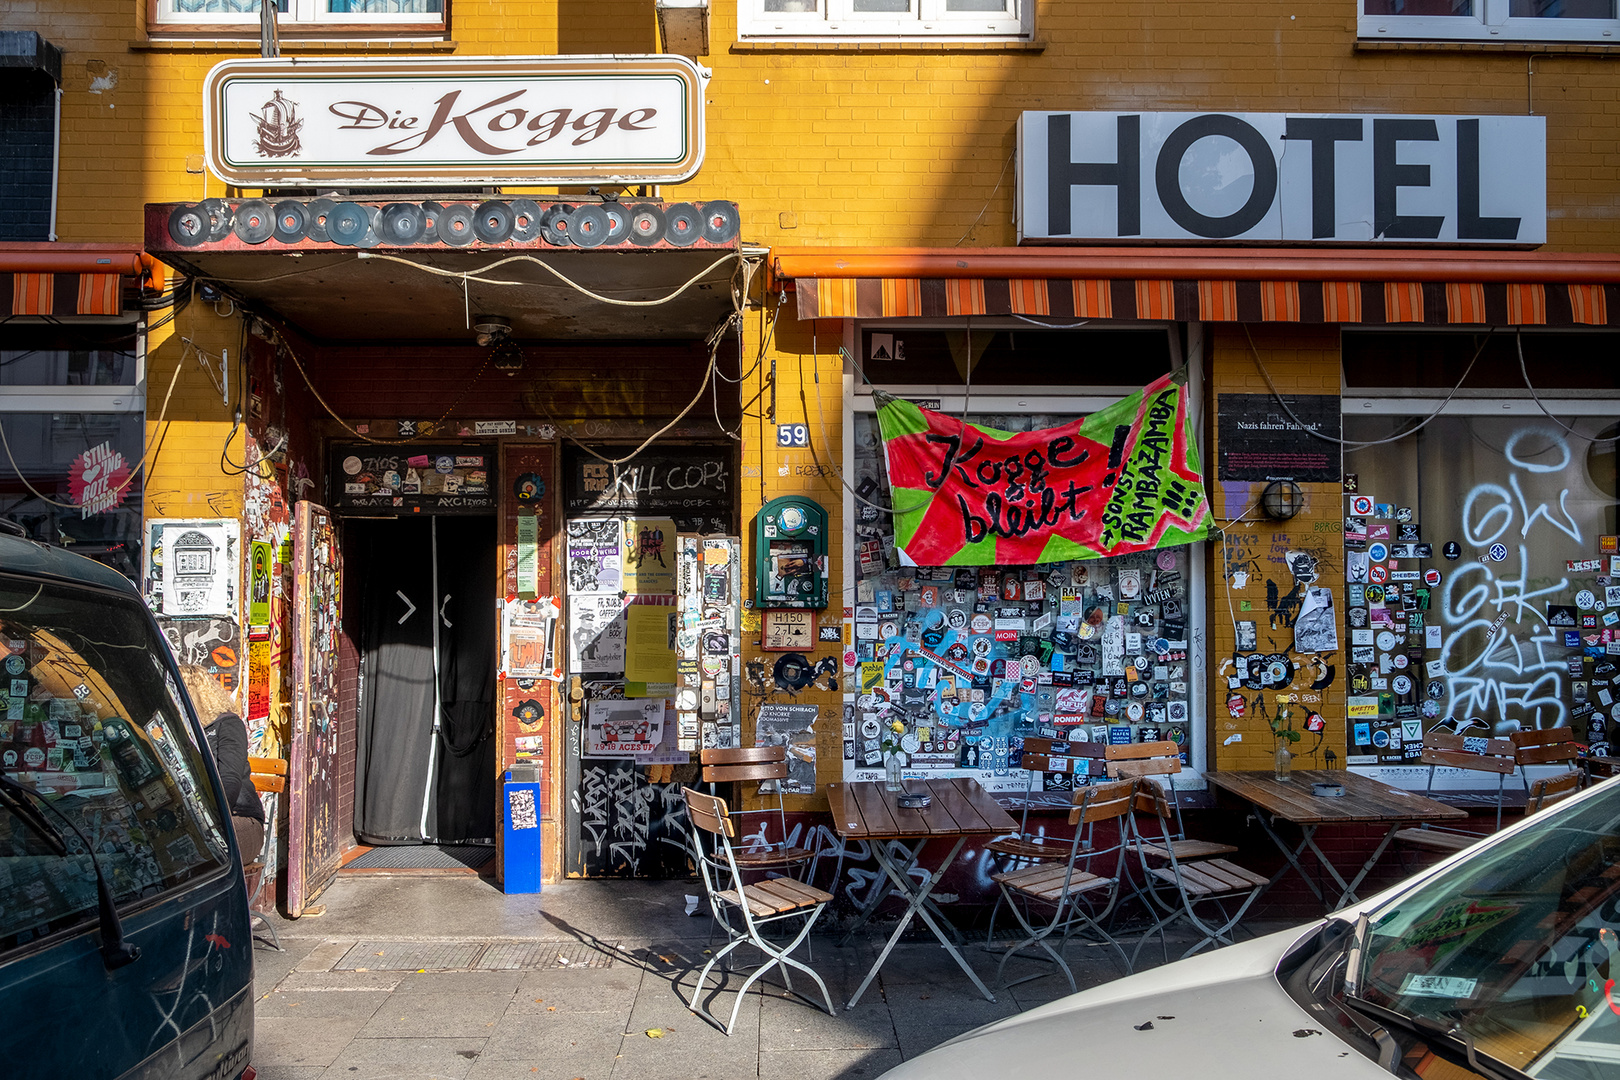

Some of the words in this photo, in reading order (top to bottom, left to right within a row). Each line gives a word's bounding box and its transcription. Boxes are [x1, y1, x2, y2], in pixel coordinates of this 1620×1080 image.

[328, 101, 419, 130] Die
[365, 89, 659, 155] Kogge
[1047, 113, 1522, 240] HOTEL
[779, 425, 807, 447] 59
[1237, 421, 1259, 430] Nazis
[1260, 420, 1285, 430] fahren
[82, 440, 112, 469] STILL
[925, 433, 1090, 502] Kogge
[82, 474, 110, 503] ROTE
[957, 480, 1094, 544] bleibt
[995, 632, 1017, 640] MOIN
[1351, 705, 1376, 713] GHETTO
[593, 743, 617, 751] 7.9.18
[619, 743, 642, 751] ACES
